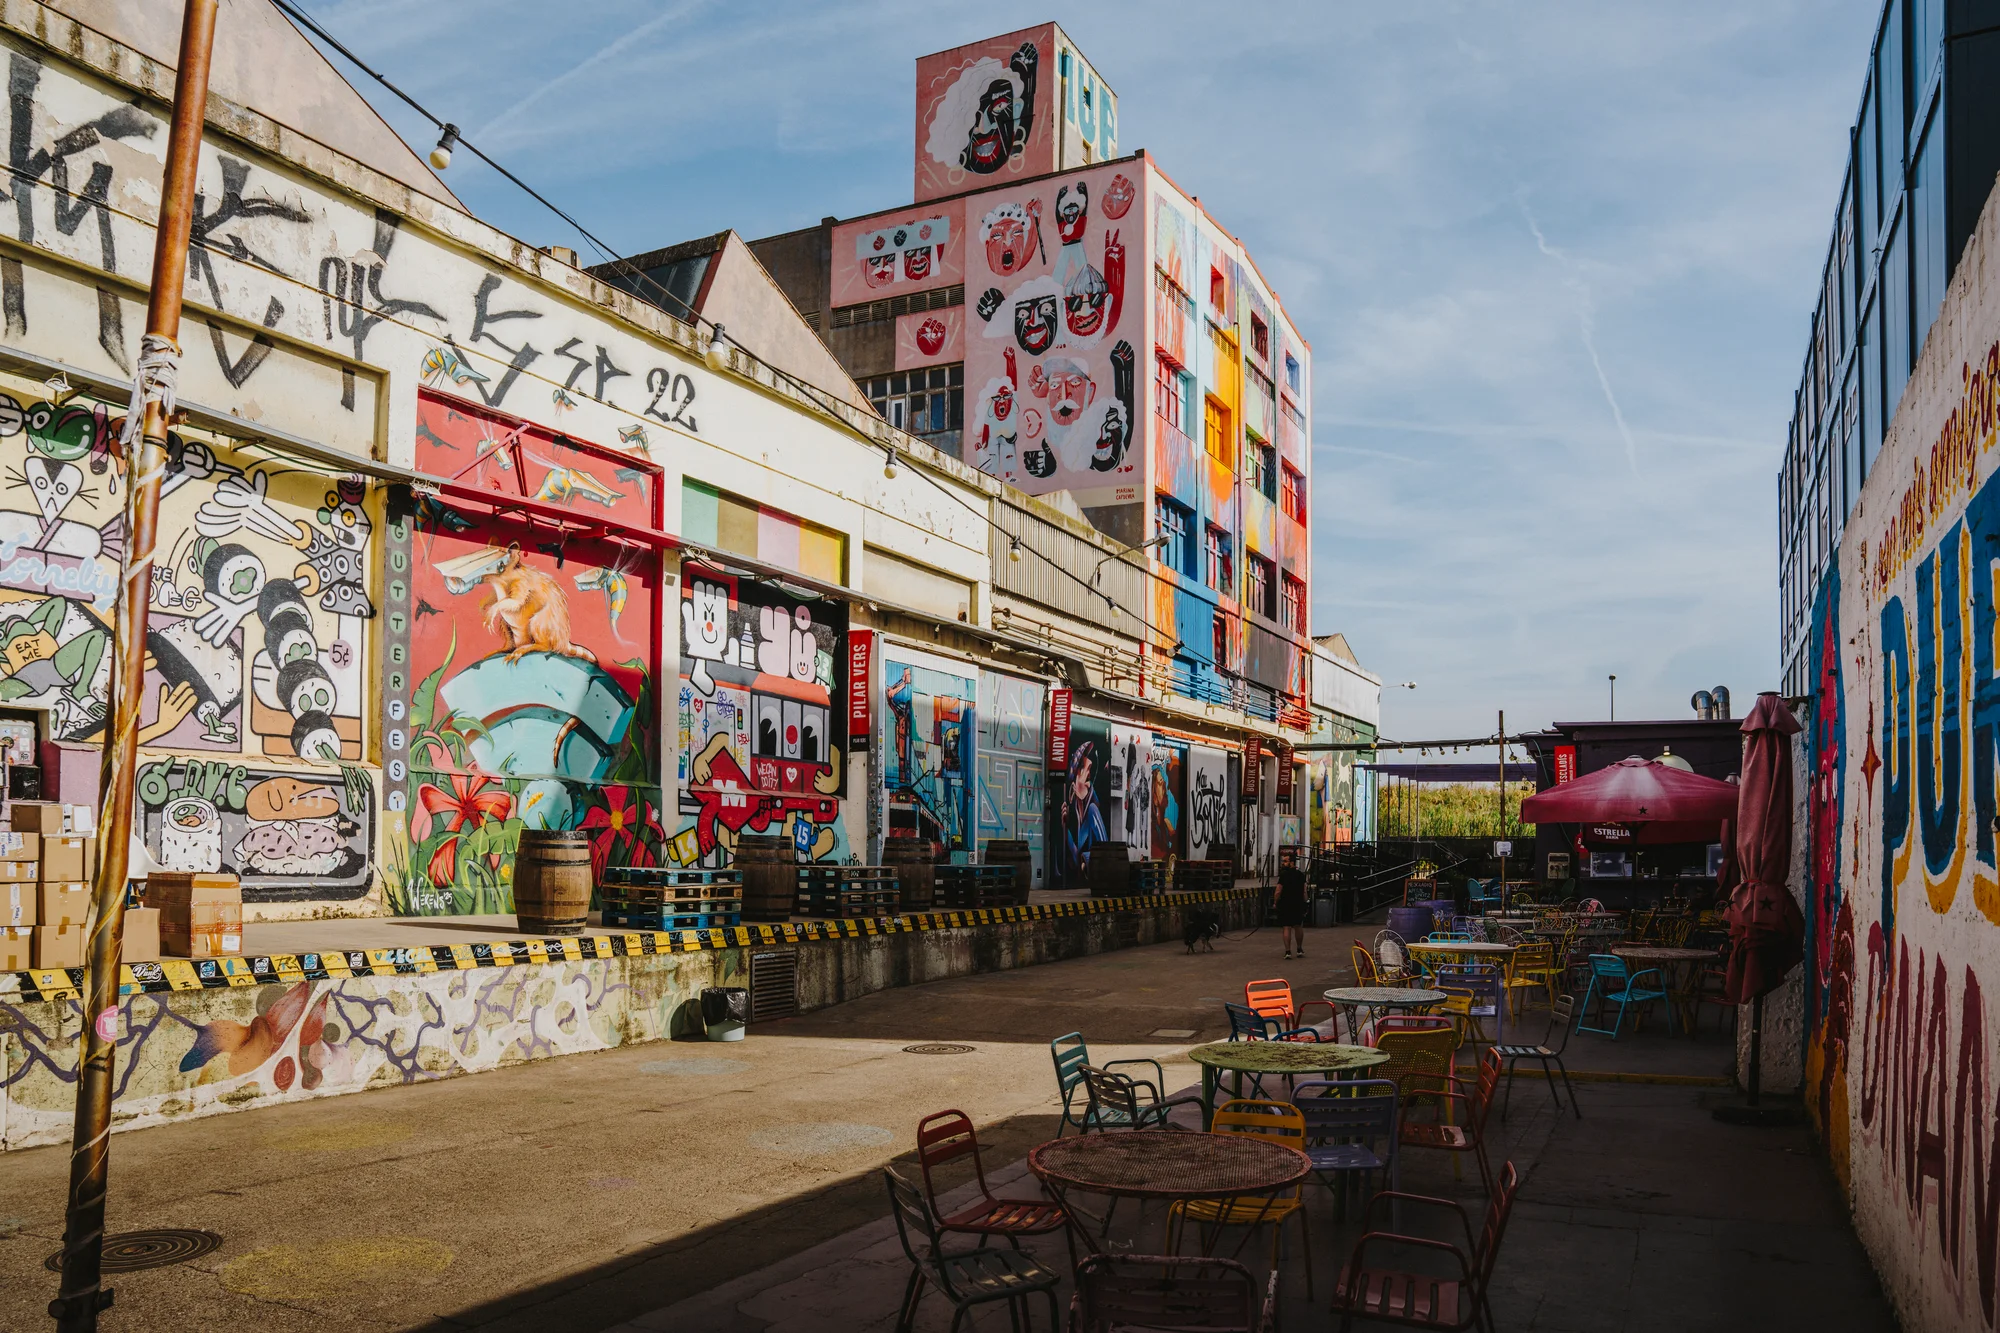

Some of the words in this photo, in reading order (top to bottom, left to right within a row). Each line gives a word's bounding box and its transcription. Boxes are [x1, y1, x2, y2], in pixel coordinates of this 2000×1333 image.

[15, 638, 40, 654] EAT
[21, 648, 42, 663] ME
[853, 643, 867, 676] VERS
[853, 680, 867, 718] PILAR
[1053, 691, 1069, 732] WARHOL
[1052, 736, 1066, 762] ANDY
[1248, 740, 1258, 767] CENTRAL
[1247, 769, 1256, 792] BOSTIK
[1280, 769, 1290, 785] SALA
[1557, 754, 1568, 785] ESCLADÍS
[797, 825, 809, 845] L5
[1593, 828, 1630, 837] ESTRELLA
[678, 832, 698, 860] L4
